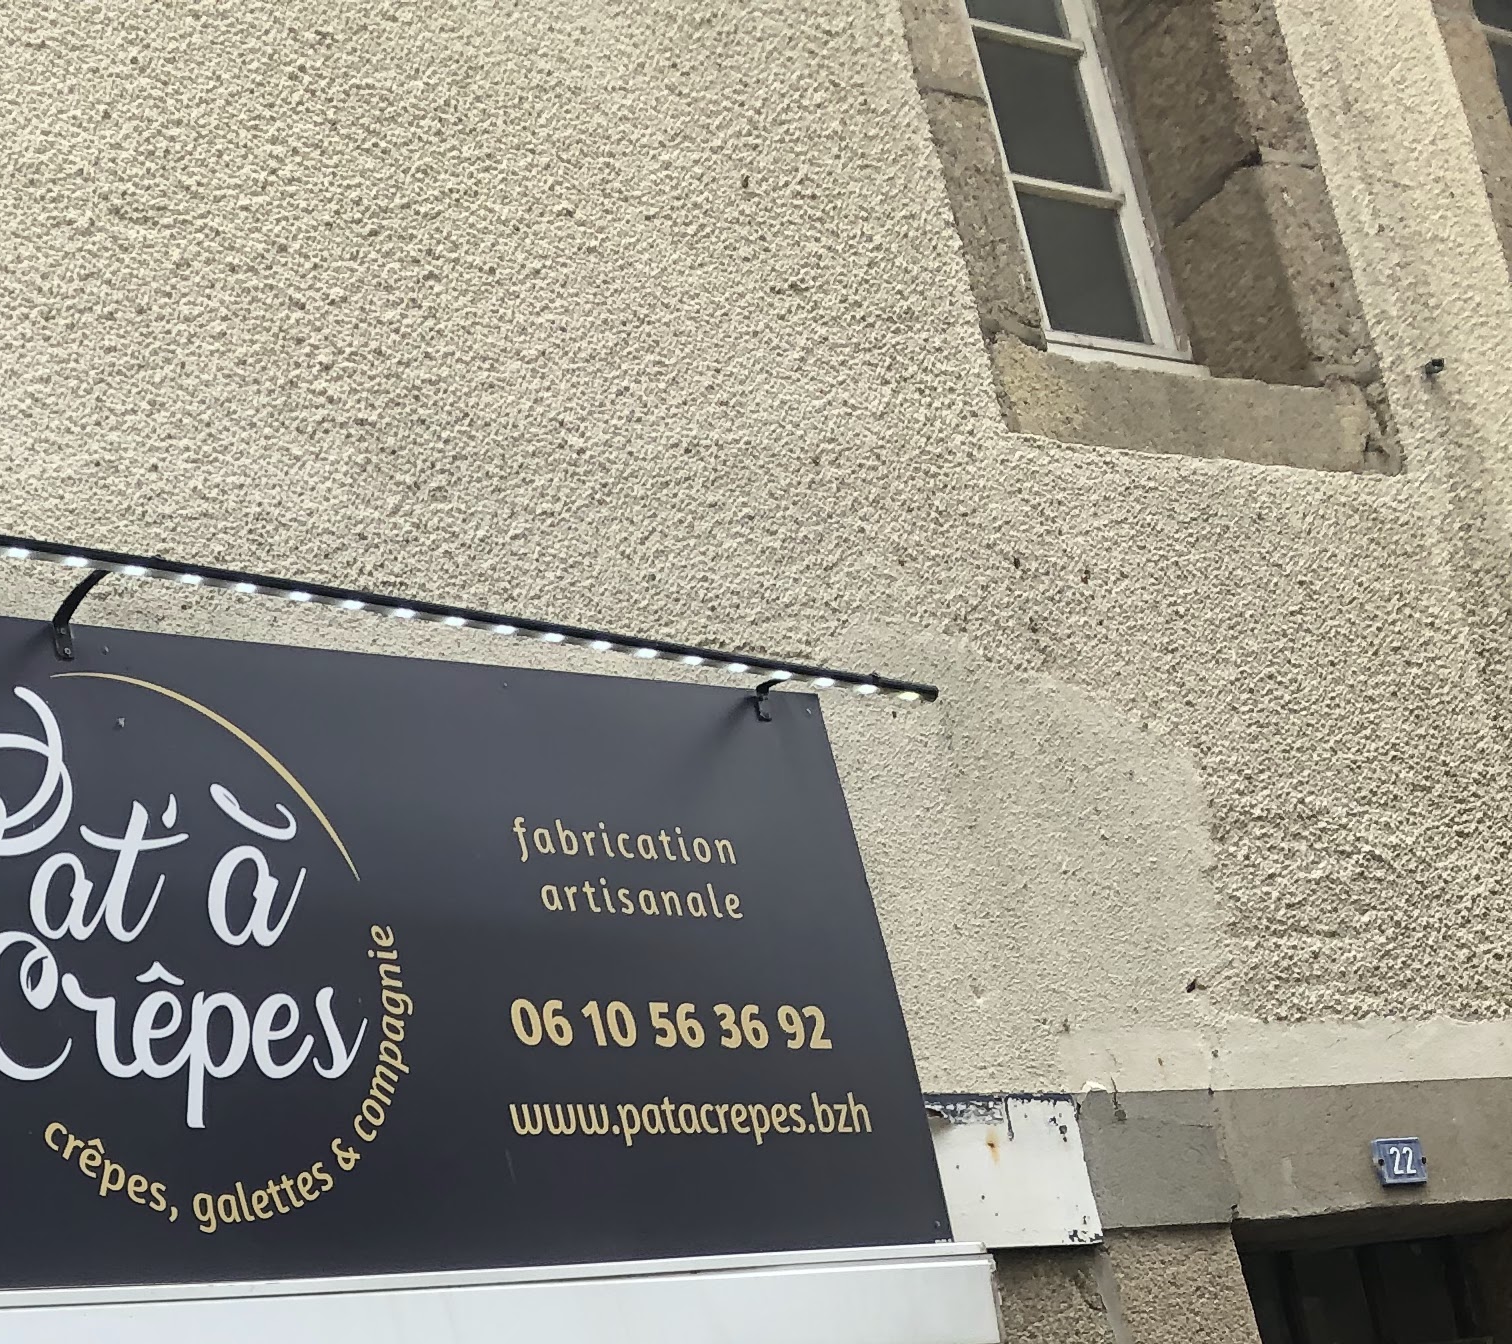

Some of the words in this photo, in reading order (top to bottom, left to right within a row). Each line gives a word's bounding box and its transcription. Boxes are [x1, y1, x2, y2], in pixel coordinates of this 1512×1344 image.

[208, 783, 307, 946] à
[513, 817, 736, 864] fabrication
[542, 878, 743, 918] artisanale
[511, 999, 572, 1046] 06
[582, 1001, 636, 1046] 10
[649, 1002, 704, 1048] 56
[714, 1004, 768, 1048] 36
[778, 1006, 832, 1049] 92
[45, 1123, 177, 1222] crêpes,
[193, 1162, 333, 1233] galettes
[332, 1138, 360, 1170] &
[352, 926, 412, 1141] compagnie
[510, 1092, 871, 1146] www.patacrepes.bzh
[1389, 1146, 1417, 1175] 22
